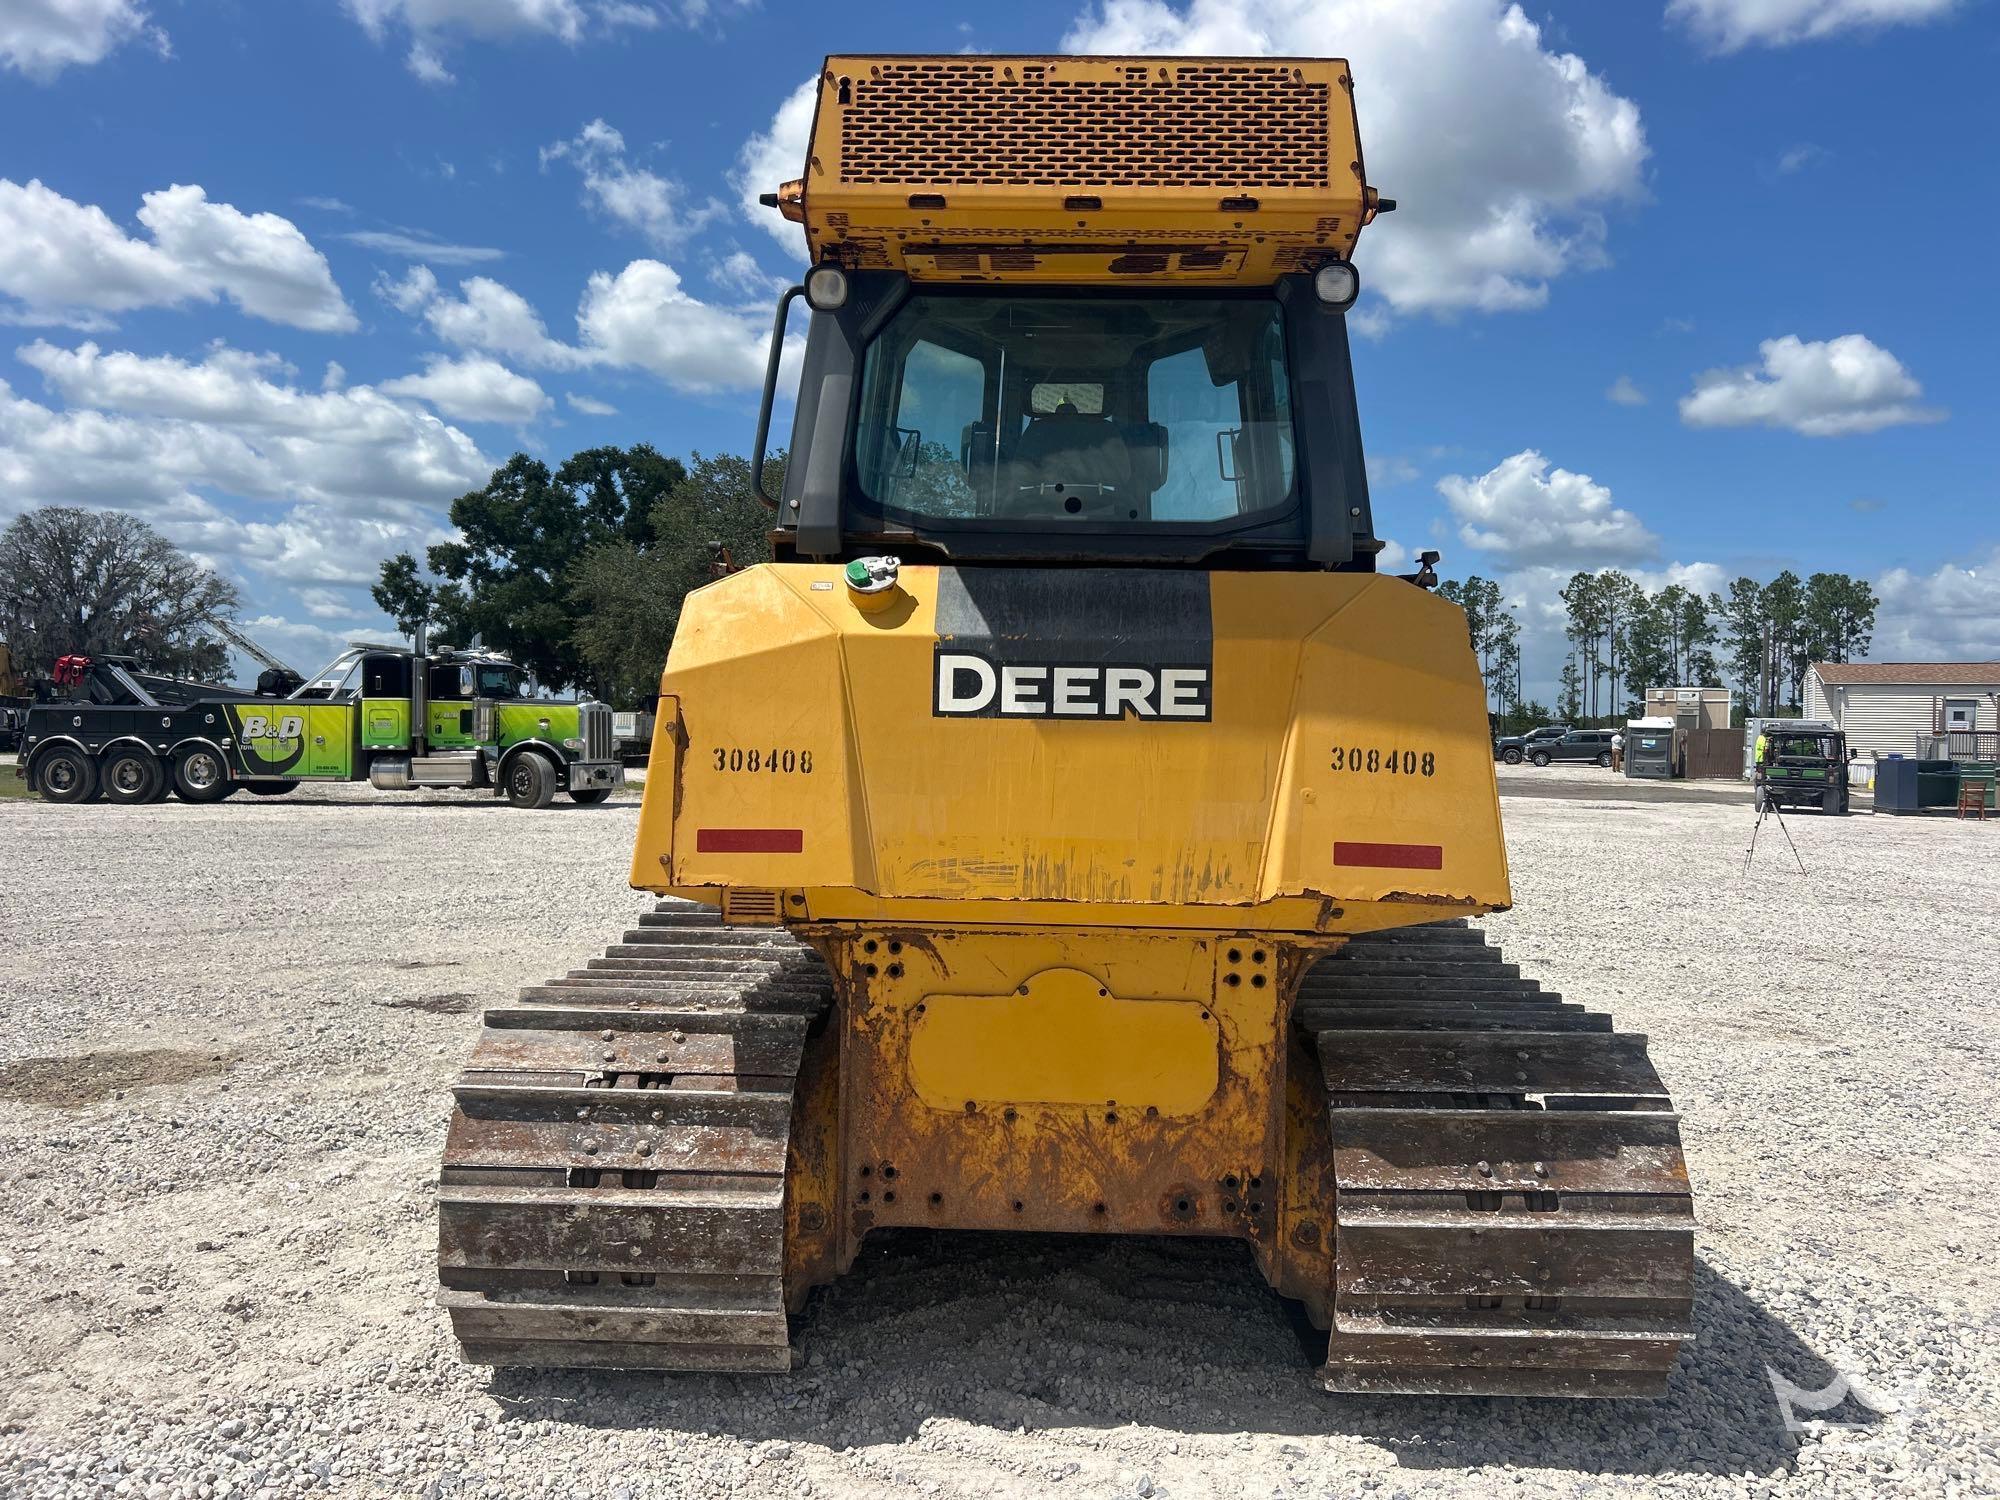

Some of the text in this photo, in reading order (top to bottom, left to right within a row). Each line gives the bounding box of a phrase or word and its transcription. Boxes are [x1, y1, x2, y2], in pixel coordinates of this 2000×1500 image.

[938, 655, 1207, 716] DEERE
[241, 716, 304, 738] B&D
[713, 748, 813, 774] 308408
[1331, 746, 1435, 778] 308408
